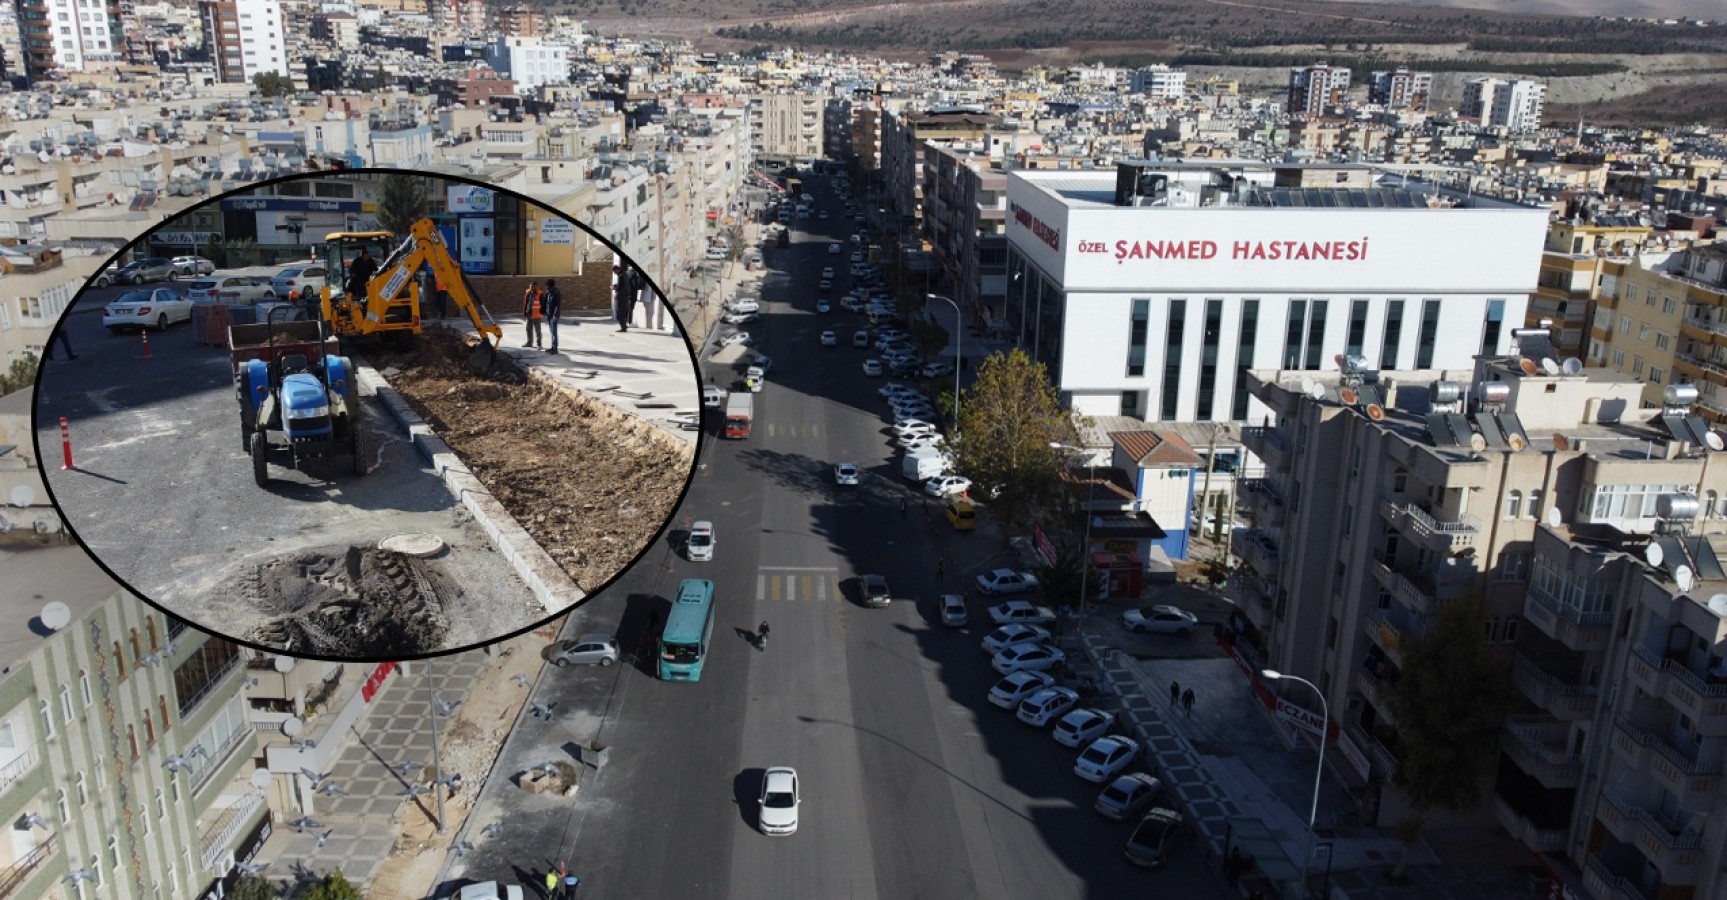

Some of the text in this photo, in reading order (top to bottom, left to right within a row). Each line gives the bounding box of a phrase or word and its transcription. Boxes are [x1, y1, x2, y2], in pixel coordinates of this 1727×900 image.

[1078, 235, 1369, 265] ÖZEL ŞANMED HASTANESİ
[1278, 701, 1325, 731] ECZANE
